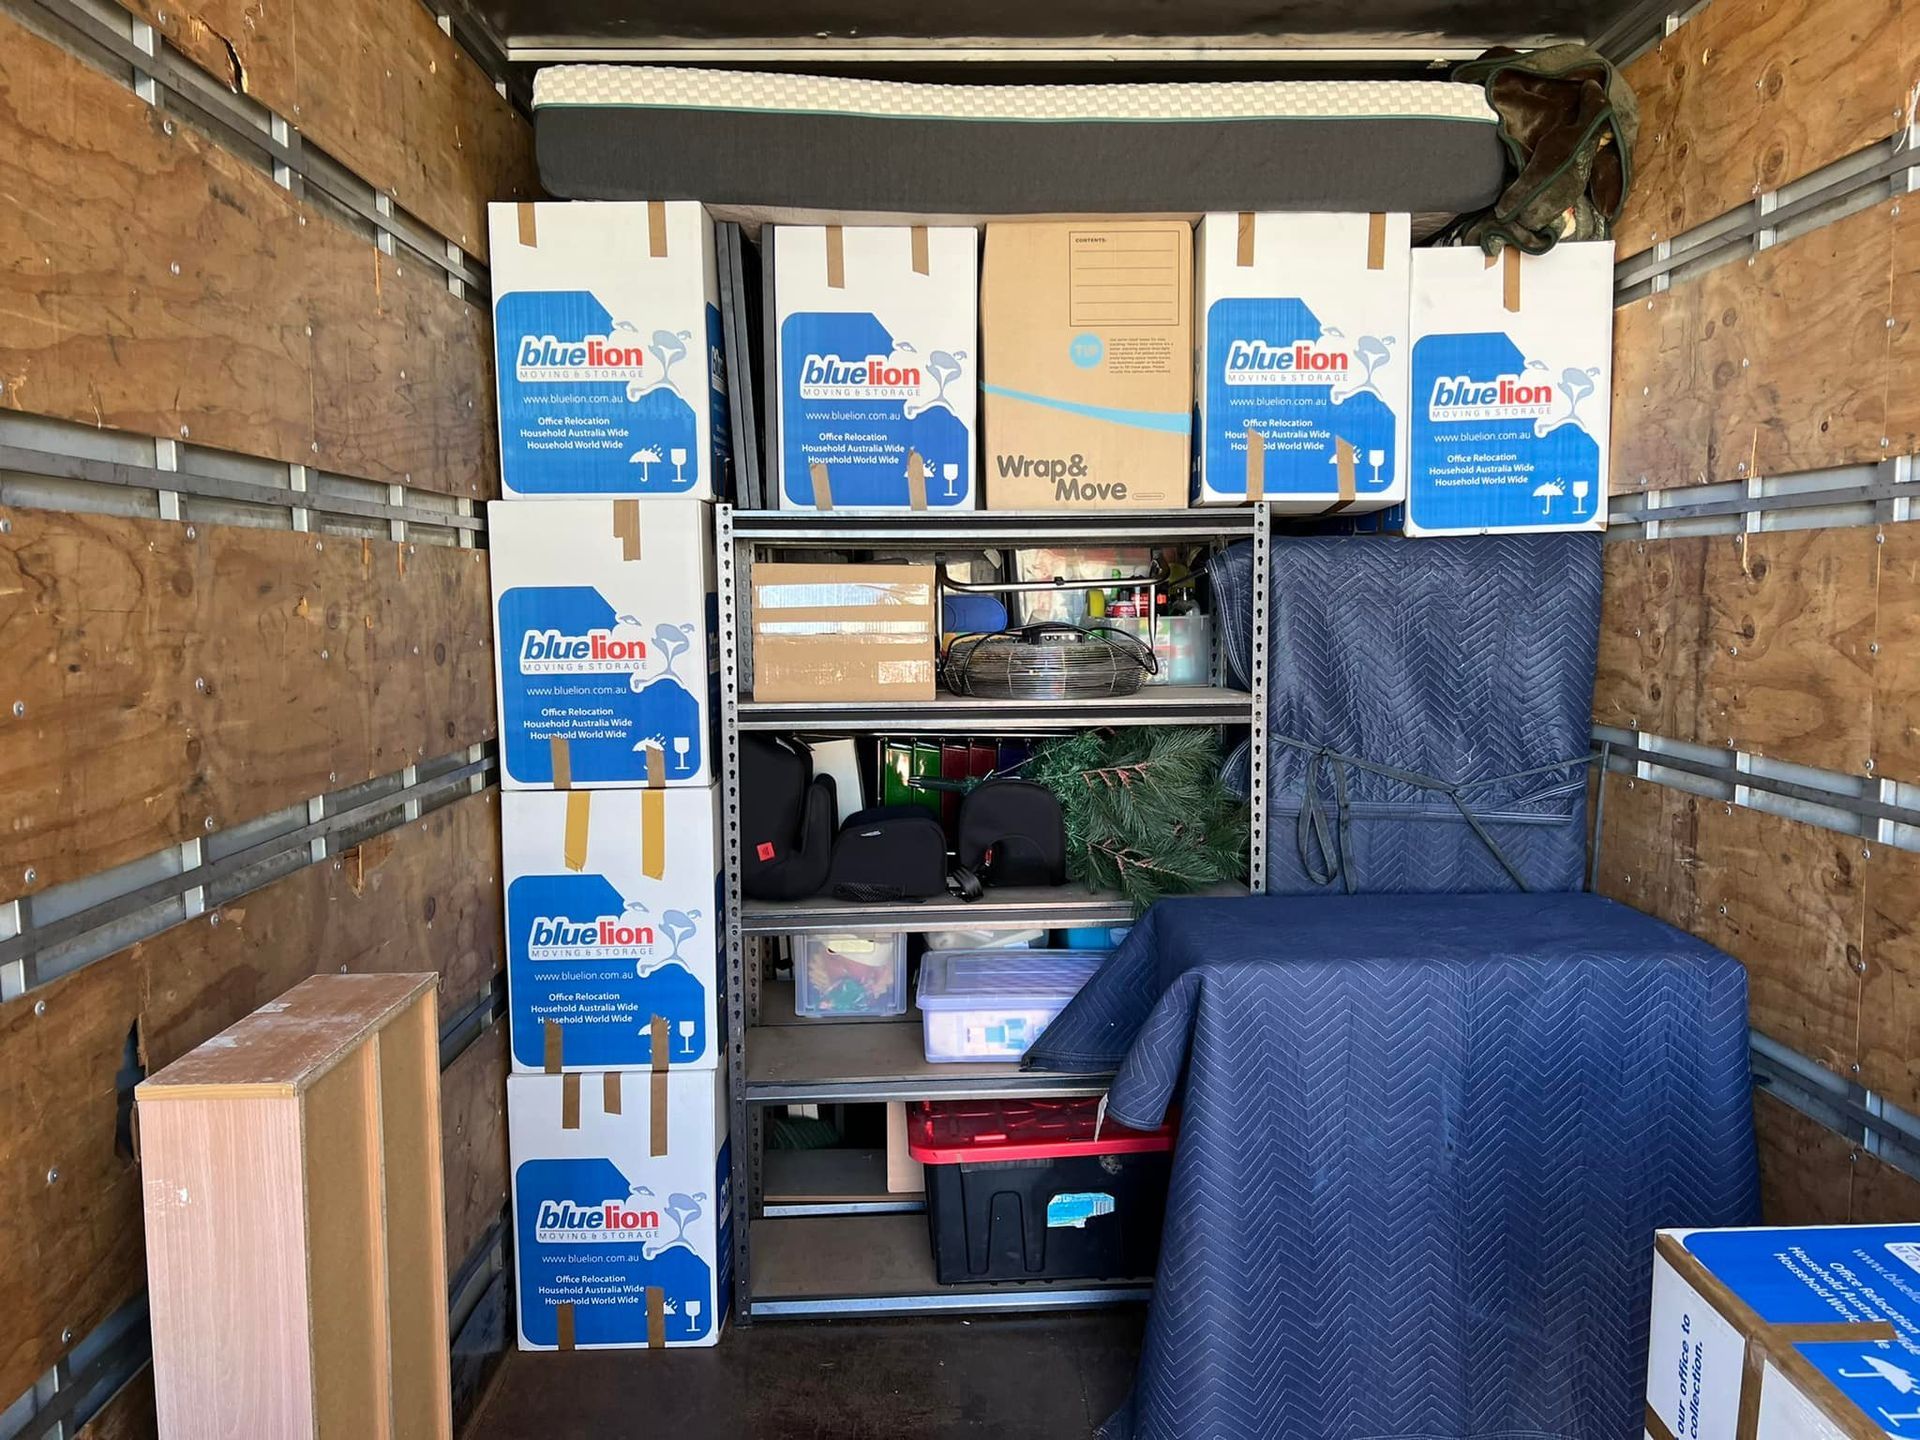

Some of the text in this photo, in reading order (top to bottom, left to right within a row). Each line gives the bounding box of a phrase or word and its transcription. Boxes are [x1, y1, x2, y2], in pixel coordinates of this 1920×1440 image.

[521, 341, 643, 367] bluelion
[1230, 346, 1347, 370] bluelion
[804, 360, 919, 385] bluelion
[1228, 374, 1276, 382] MOVING
[1434, 381, 1551, 406] bluelion
[523, 394, 623, 404] www.bluelion.com.au
[806, 411, 900, 421] www.bluelion.com.au
[1432, 410, 1480, 418] MOVING
[1495, 407, 1551, 416] STORAGE
[538, 417, 610, 426] Office Relocation
[1243, 419, 1312, 427] Office Relocation
[520, 428, 629, 438] Household Australia Wide
[819, 433, 887, 441] Office Relocation
[1225, 431, 1269, 439] Housld
[1309, 430, 1331, 439] Wide
[1434, 432, 1530, 442] www.bluelion.com.au
[527, 440, 623, 449] Household World Wide
[802, 444, 904, 452] Household Australia Wide
[1231, 442, 1324, 451] Houold World Wide
[808, 456, 851, 464] Household
[879, 456, 899, 464] Wide
[1447, 453, 1516, 463] Office Relocation
[997, 454, 1088, 483] Wrap&
[1429, 464, 1535, 475] Household Australia Wide
[1435, 476, 1528, 486] Household World Wide
[1056, 478, 1126, 501] Move
[524, 635, 646, 660] bluelion
[523, 662, 647, 671] MOVING & STORAGE
[527, 687, 627, 696] www.bluelion.com.au
[541, 708, 614, 716] Office Relocation
[524, 719, 633, 729] Household Australia Wide
[531, 730, 627, 740] Houshold World Wide
[533, 922, 653, 946] bluelion
[532, 949, 581, 958] MOVING
[534, 971, 633, 981] www.bluelion.com.au
[549, 992, 620, 1001] Office Relocation
[531, 1003, 639, 1013] Household Australia Wide
[538, 1014, 632, 1024] Hsehold World Wide
[540, 1206, 658, 1229] bluelion
[539, 1232, 587, 1240] MOVING
[602, 1231, 659, 1239] STORAGE
[542, 1254, 639, 1263] www.bluelion.com.au
[556, 1275, 625, 1284] Office Relocation
[1773, 1253, 1834, 1298] Household
[1788, 1246, 1848, 1291] Household
[1841, 1291, 1888, 1322] Austral
[539, 1285, 644, 1294] Household Australia Wide
[591, 1296, 616, 1305] World
[617, 1296, 639, 1304] Wide
[1830, 1262, 1862, 1286] Office
[1860, 1288, 1920, 1334] Relocation
[1681, 1314, 1690, 1335] to
[1679, 1340, 1689, 1395] office
[1690, 1341, 1703, 1439] collection.
